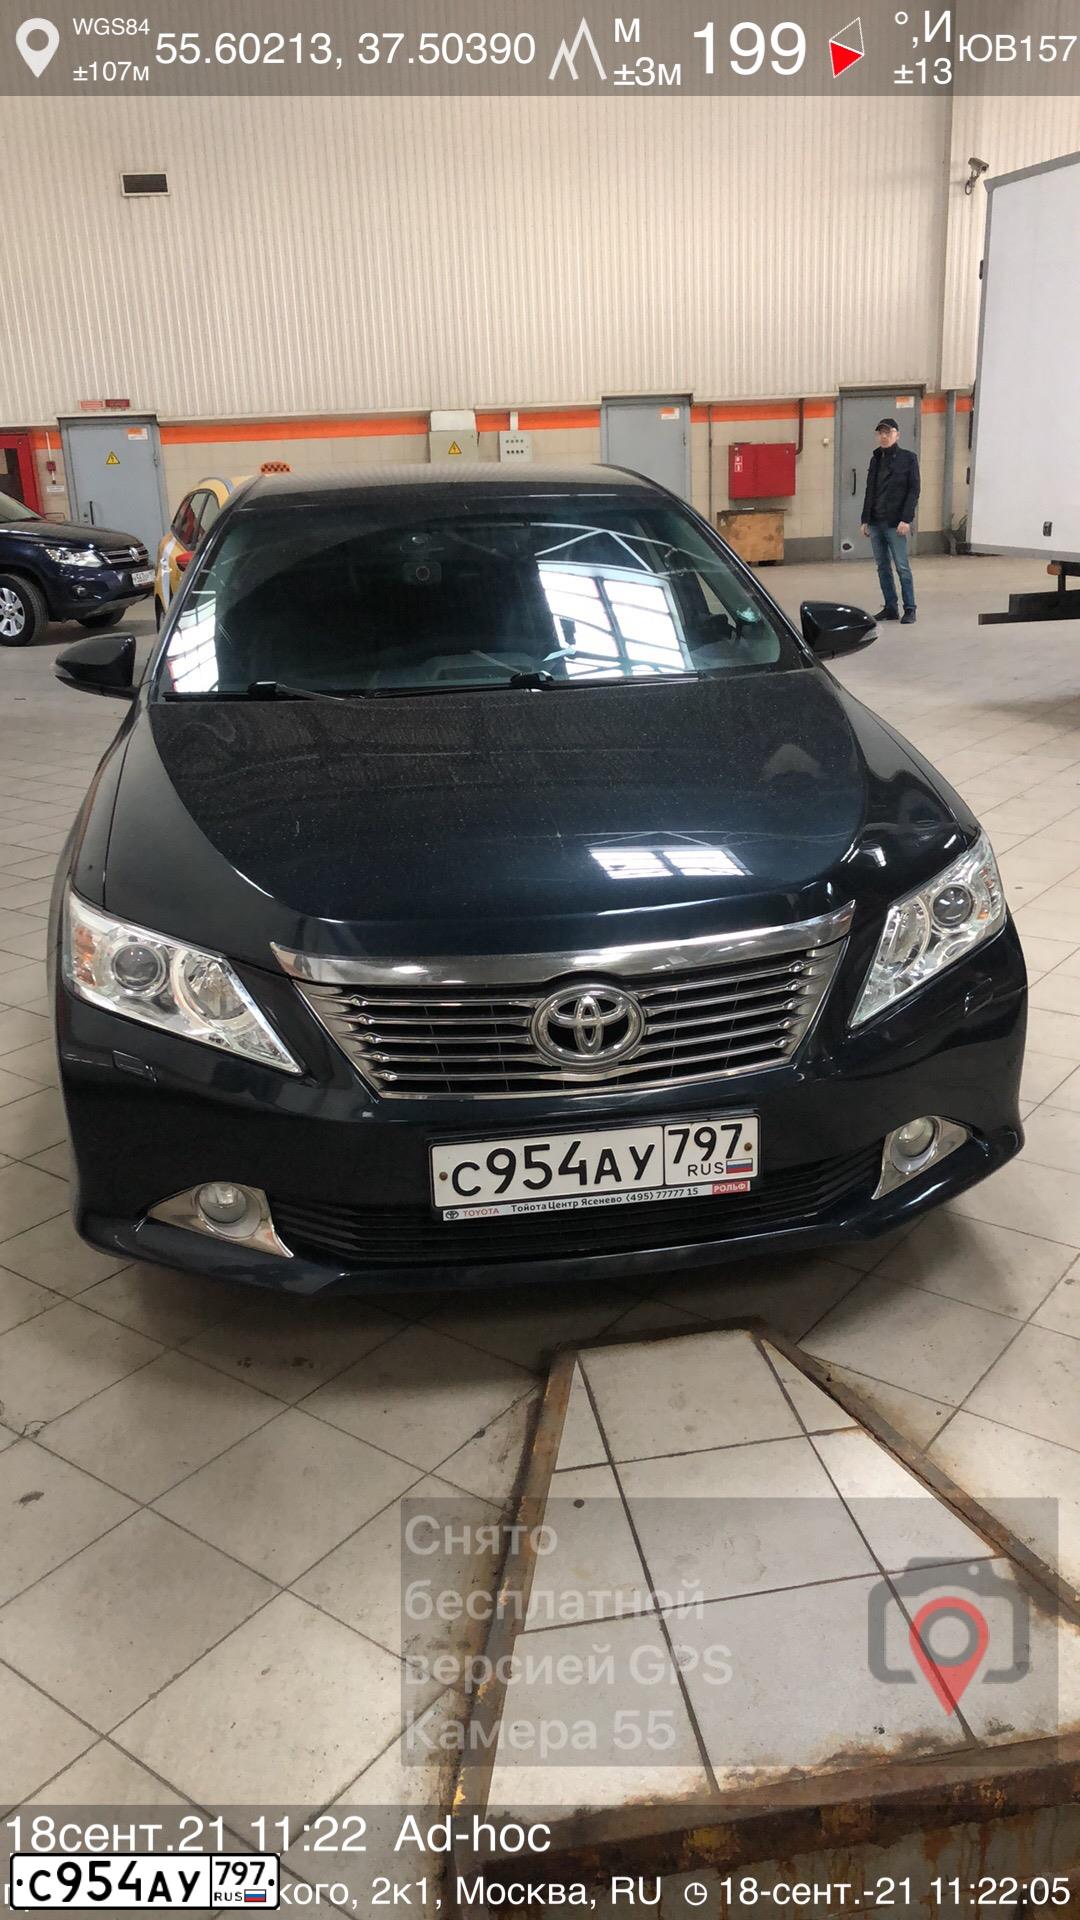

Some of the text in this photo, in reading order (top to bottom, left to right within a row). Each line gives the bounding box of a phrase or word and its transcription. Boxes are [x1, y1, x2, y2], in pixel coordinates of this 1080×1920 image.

[667, 1122, 743, 1165] 797
[687, 1161, 725, 1177] RUS
[713, 1182, 747, 1193] РОЛЬФ
[581, 1196, 622, 1207] Ясенево
[625, 1191, 654, 1203] (495)
[462, 1207, 500, 1217] TOYOTA
